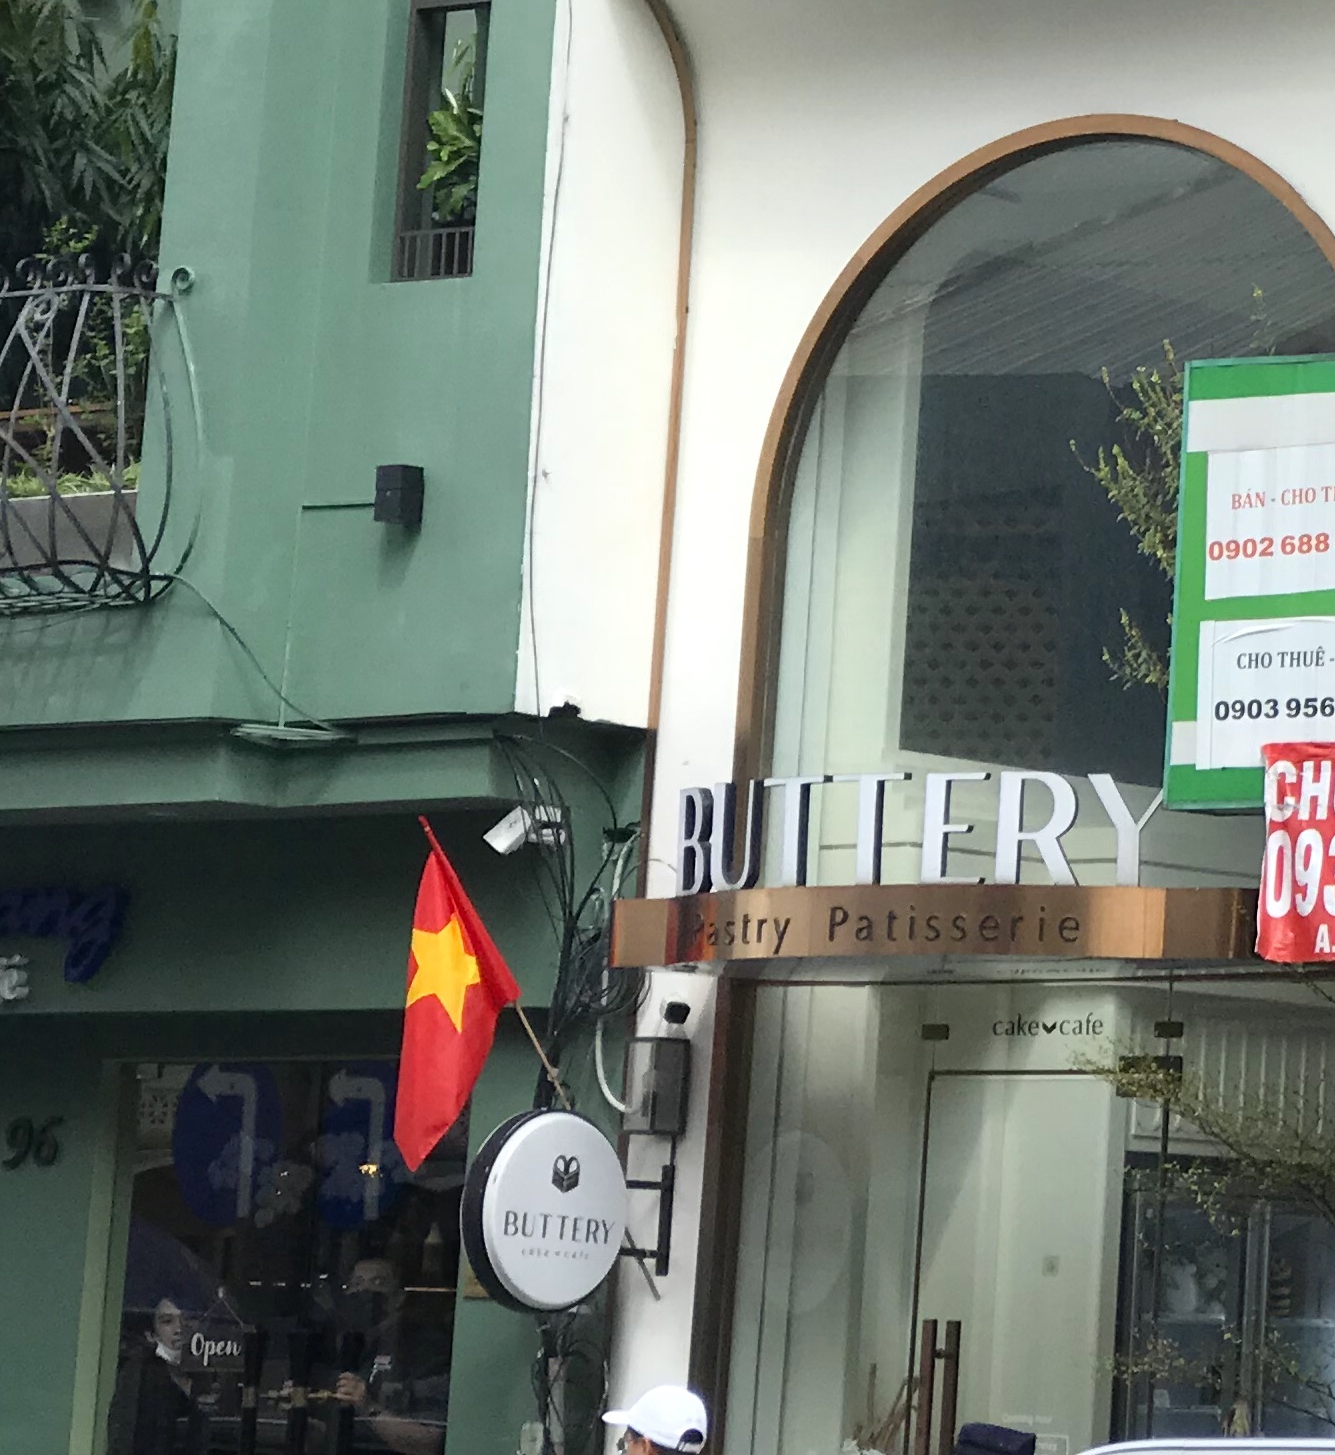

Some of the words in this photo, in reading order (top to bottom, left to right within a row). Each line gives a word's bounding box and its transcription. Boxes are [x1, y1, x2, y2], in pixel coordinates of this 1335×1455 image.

[1231, 488, 1266, 510] BÁN
[1281, 487, 1317, 506] CHO
[1208, 536, 1274, 561] 0902
[1280, 532, 1330, 556] 688
[1237, 651, 1272, 670] CHO
[1277, 646, 1325, 668] THUÊ
[1214, 698, 1279, 721] 0903
[1285, 696, 1335, 718] 956
[677, 771, 1164, 896] BUTTERY
[829, 905, 1081, 944] Patisserie
[993, 1013, 1039, 1036] cake
[1060, 1012, 1104, 1036] cafe
[503, 1210, 616, 1245] BUTTERY
[191, 1332, 242, 1366] Open
